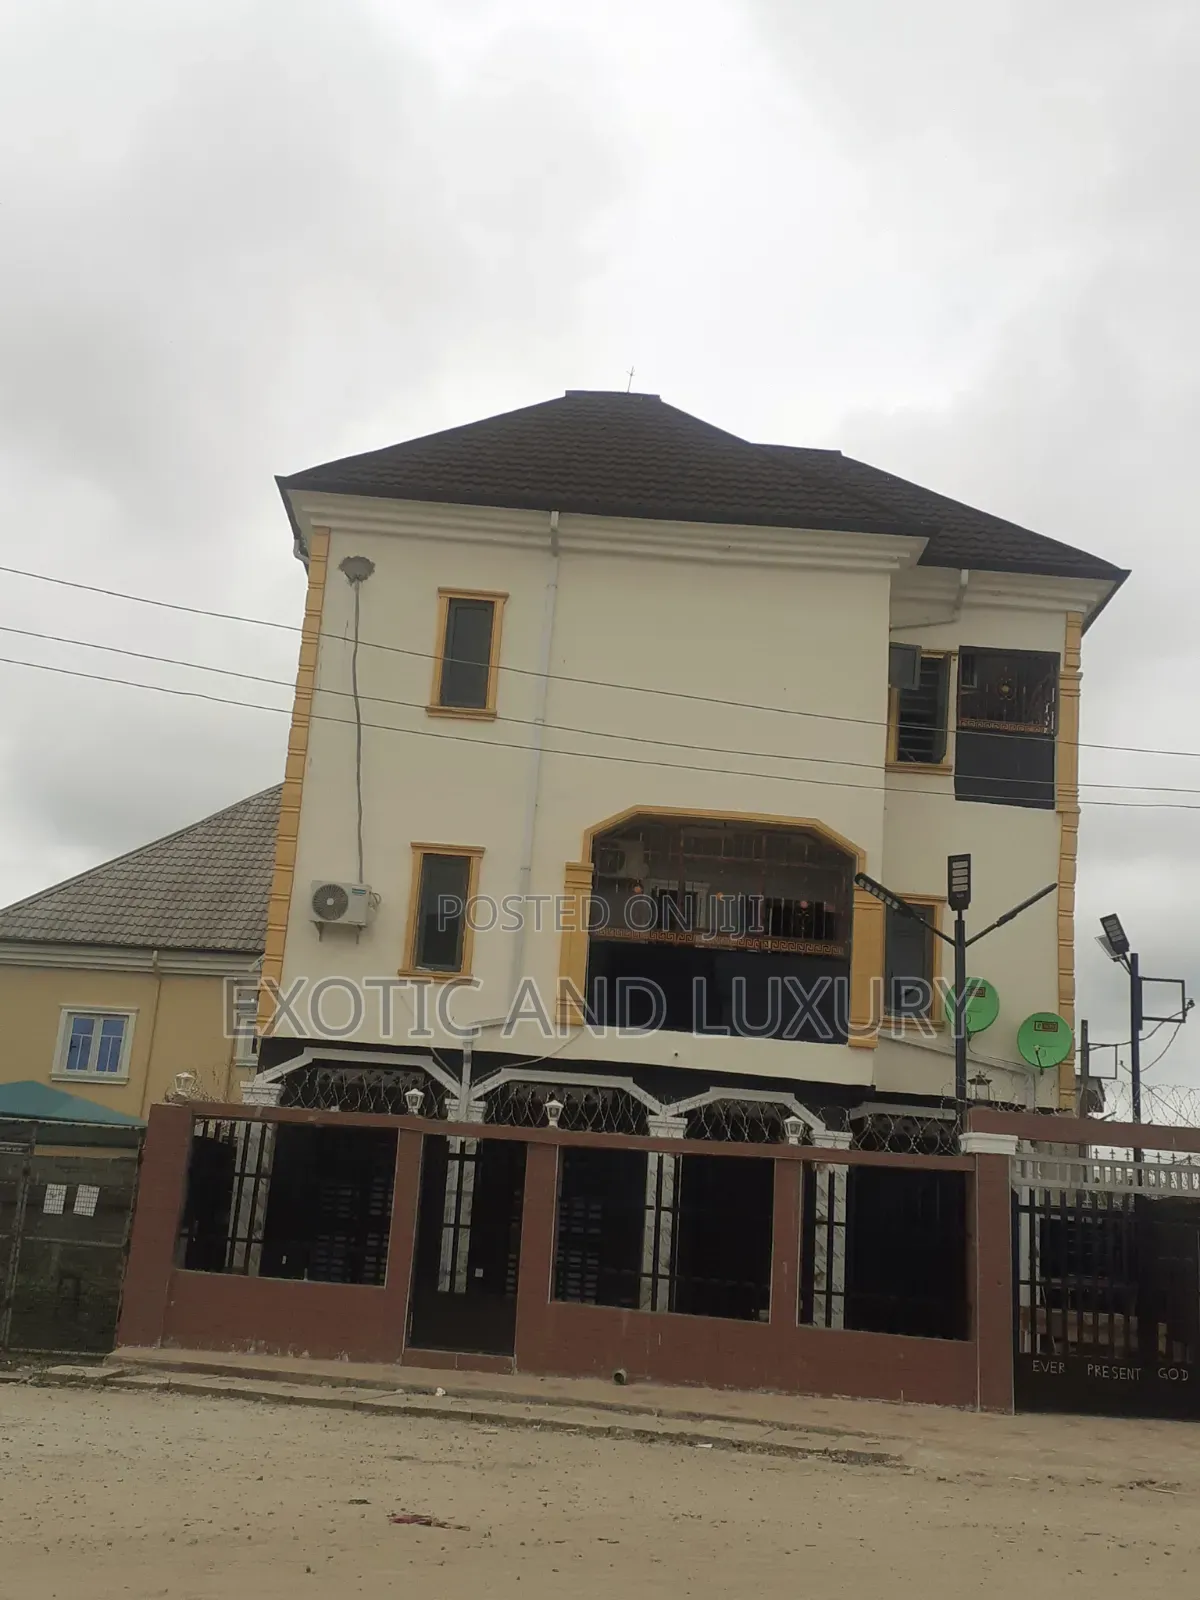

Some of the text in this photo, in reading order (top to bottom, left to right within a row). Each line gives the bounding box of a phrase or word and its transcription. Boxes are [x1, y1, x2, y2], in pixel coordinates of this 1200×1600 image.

[1032, 1360, 1189, 1381] EVER PRESENT GOD
